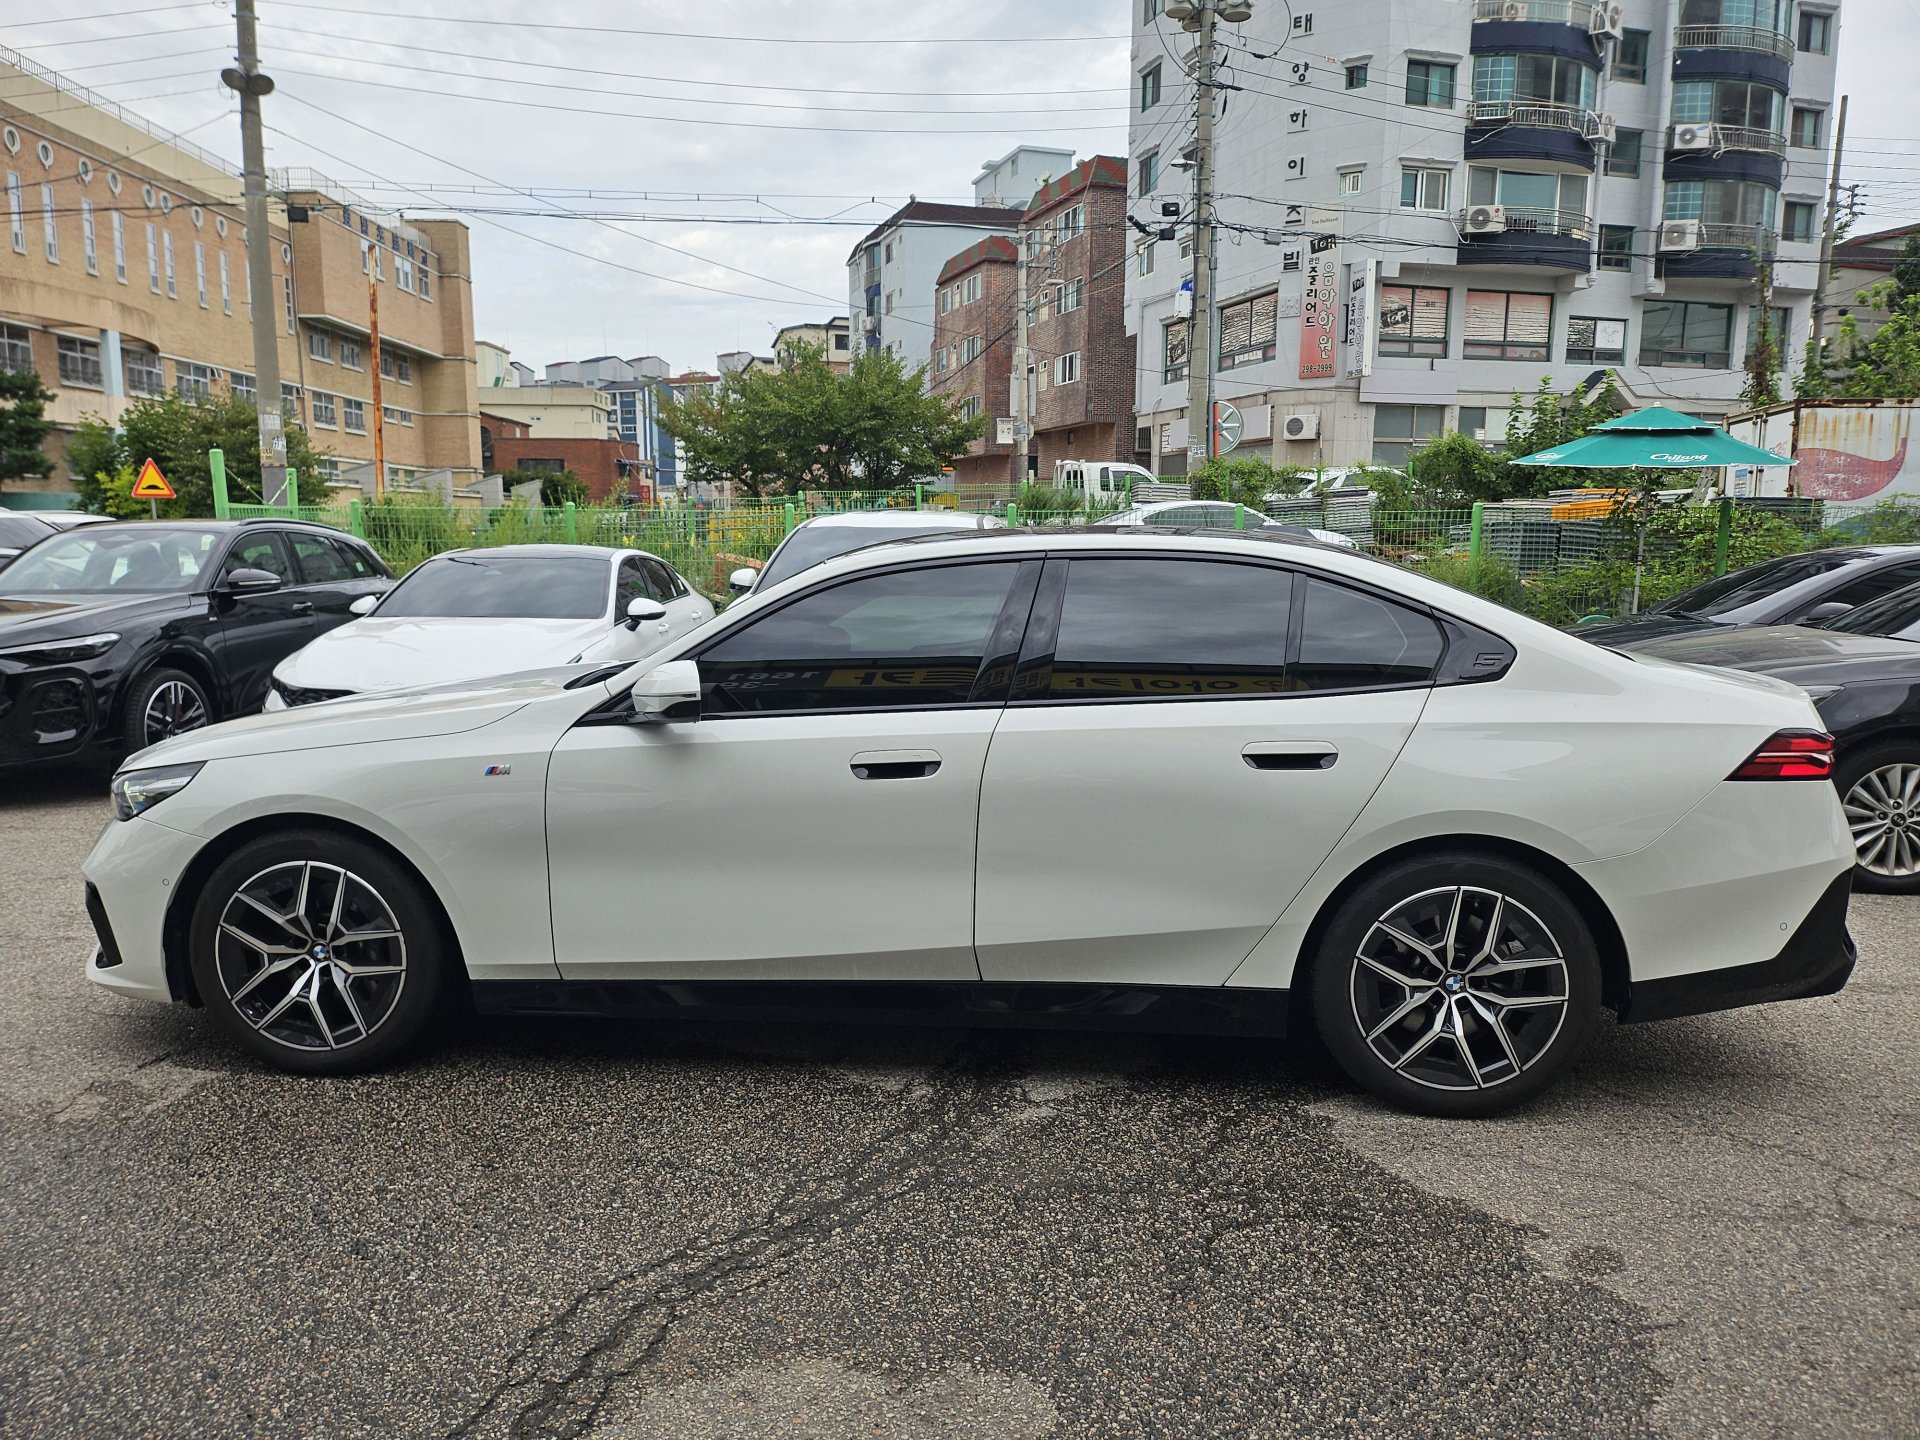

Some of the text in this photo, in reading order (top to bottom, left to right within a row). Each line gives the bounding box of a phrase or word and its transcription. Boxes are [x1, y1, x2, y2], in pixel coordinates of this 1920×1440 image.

[1304, 266, 1320, 328] 줄리어드
[1317, 261, 1337, 360] 음악학원
[1301, 363, 1332, 374] 298-2999
